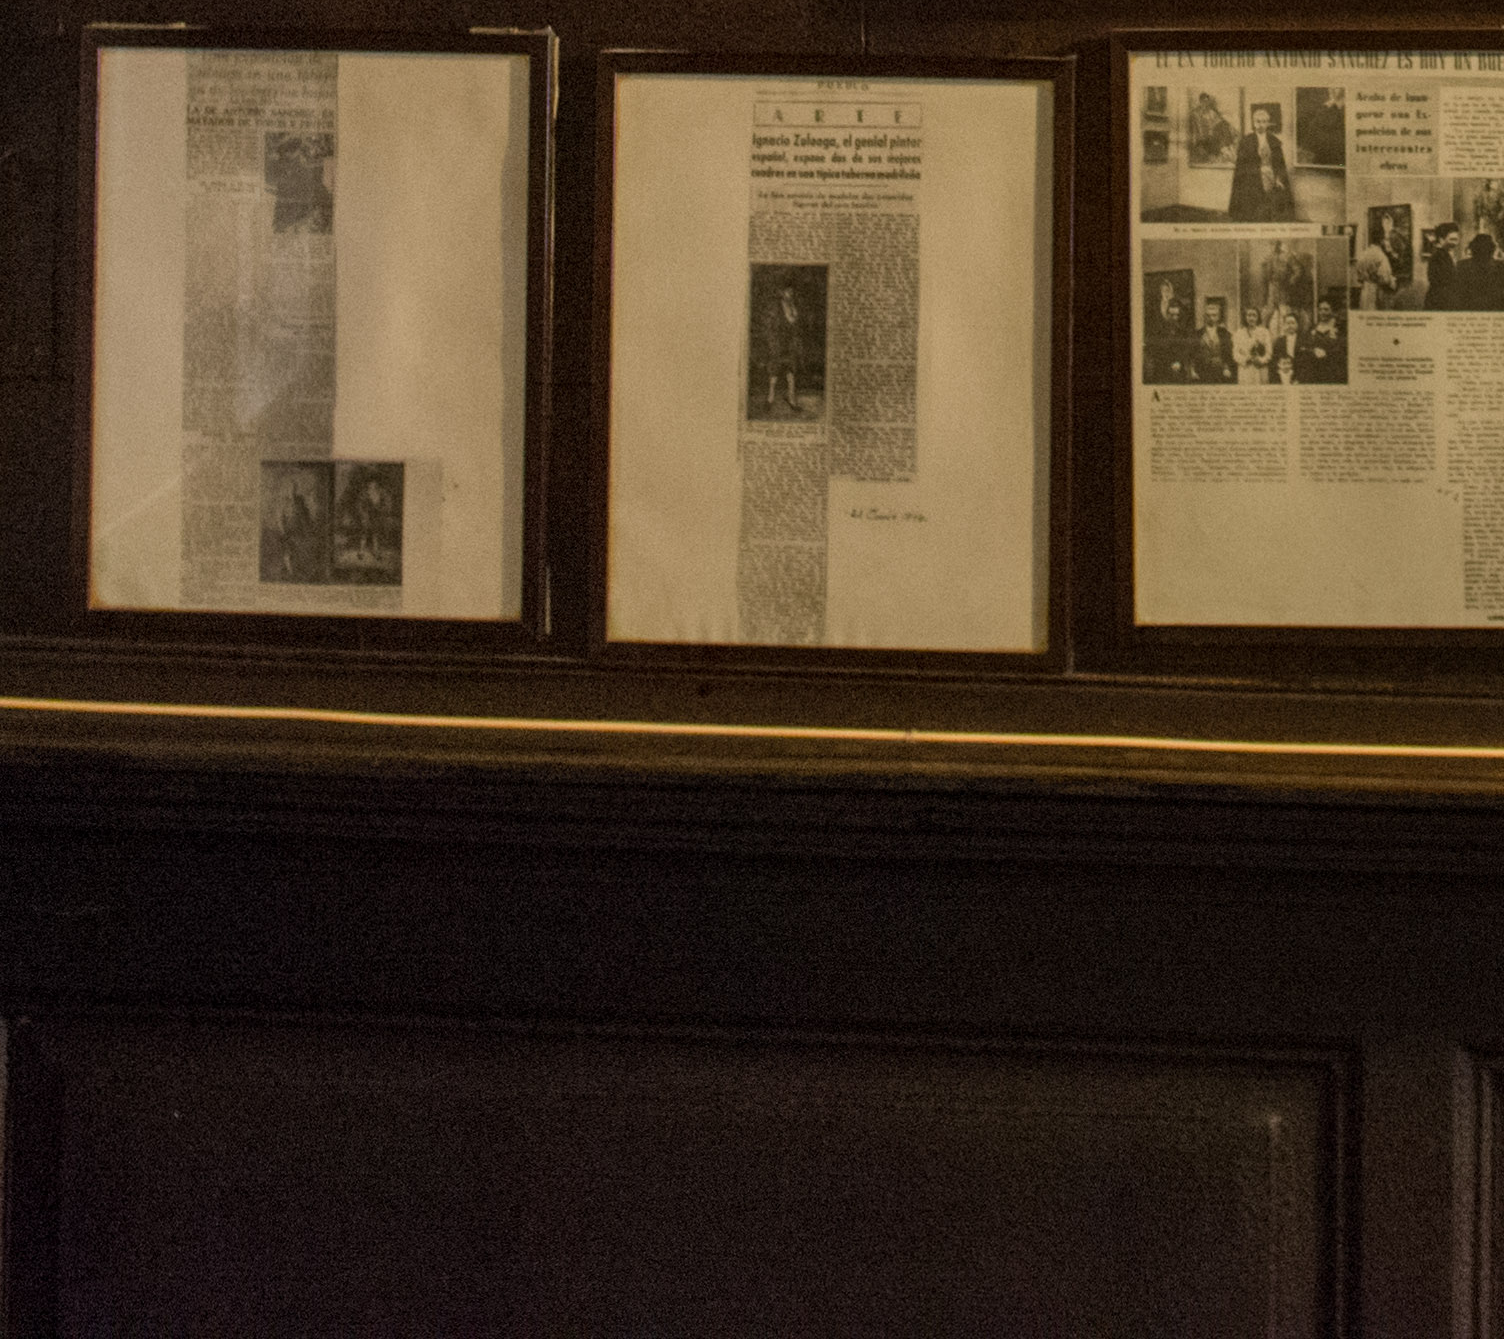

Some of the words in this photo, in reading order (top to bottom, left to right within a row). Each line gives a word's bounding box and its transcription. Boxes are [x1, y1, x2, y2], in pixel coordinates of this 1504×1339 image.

[1265, 51, 1321, 68] ANTONIO
[752, 133, 790, 149] Ignacio
[843, 134, 852, 147] el
[855, 134, 887, 150] genial
[890, 135, 922, 150] pintor
